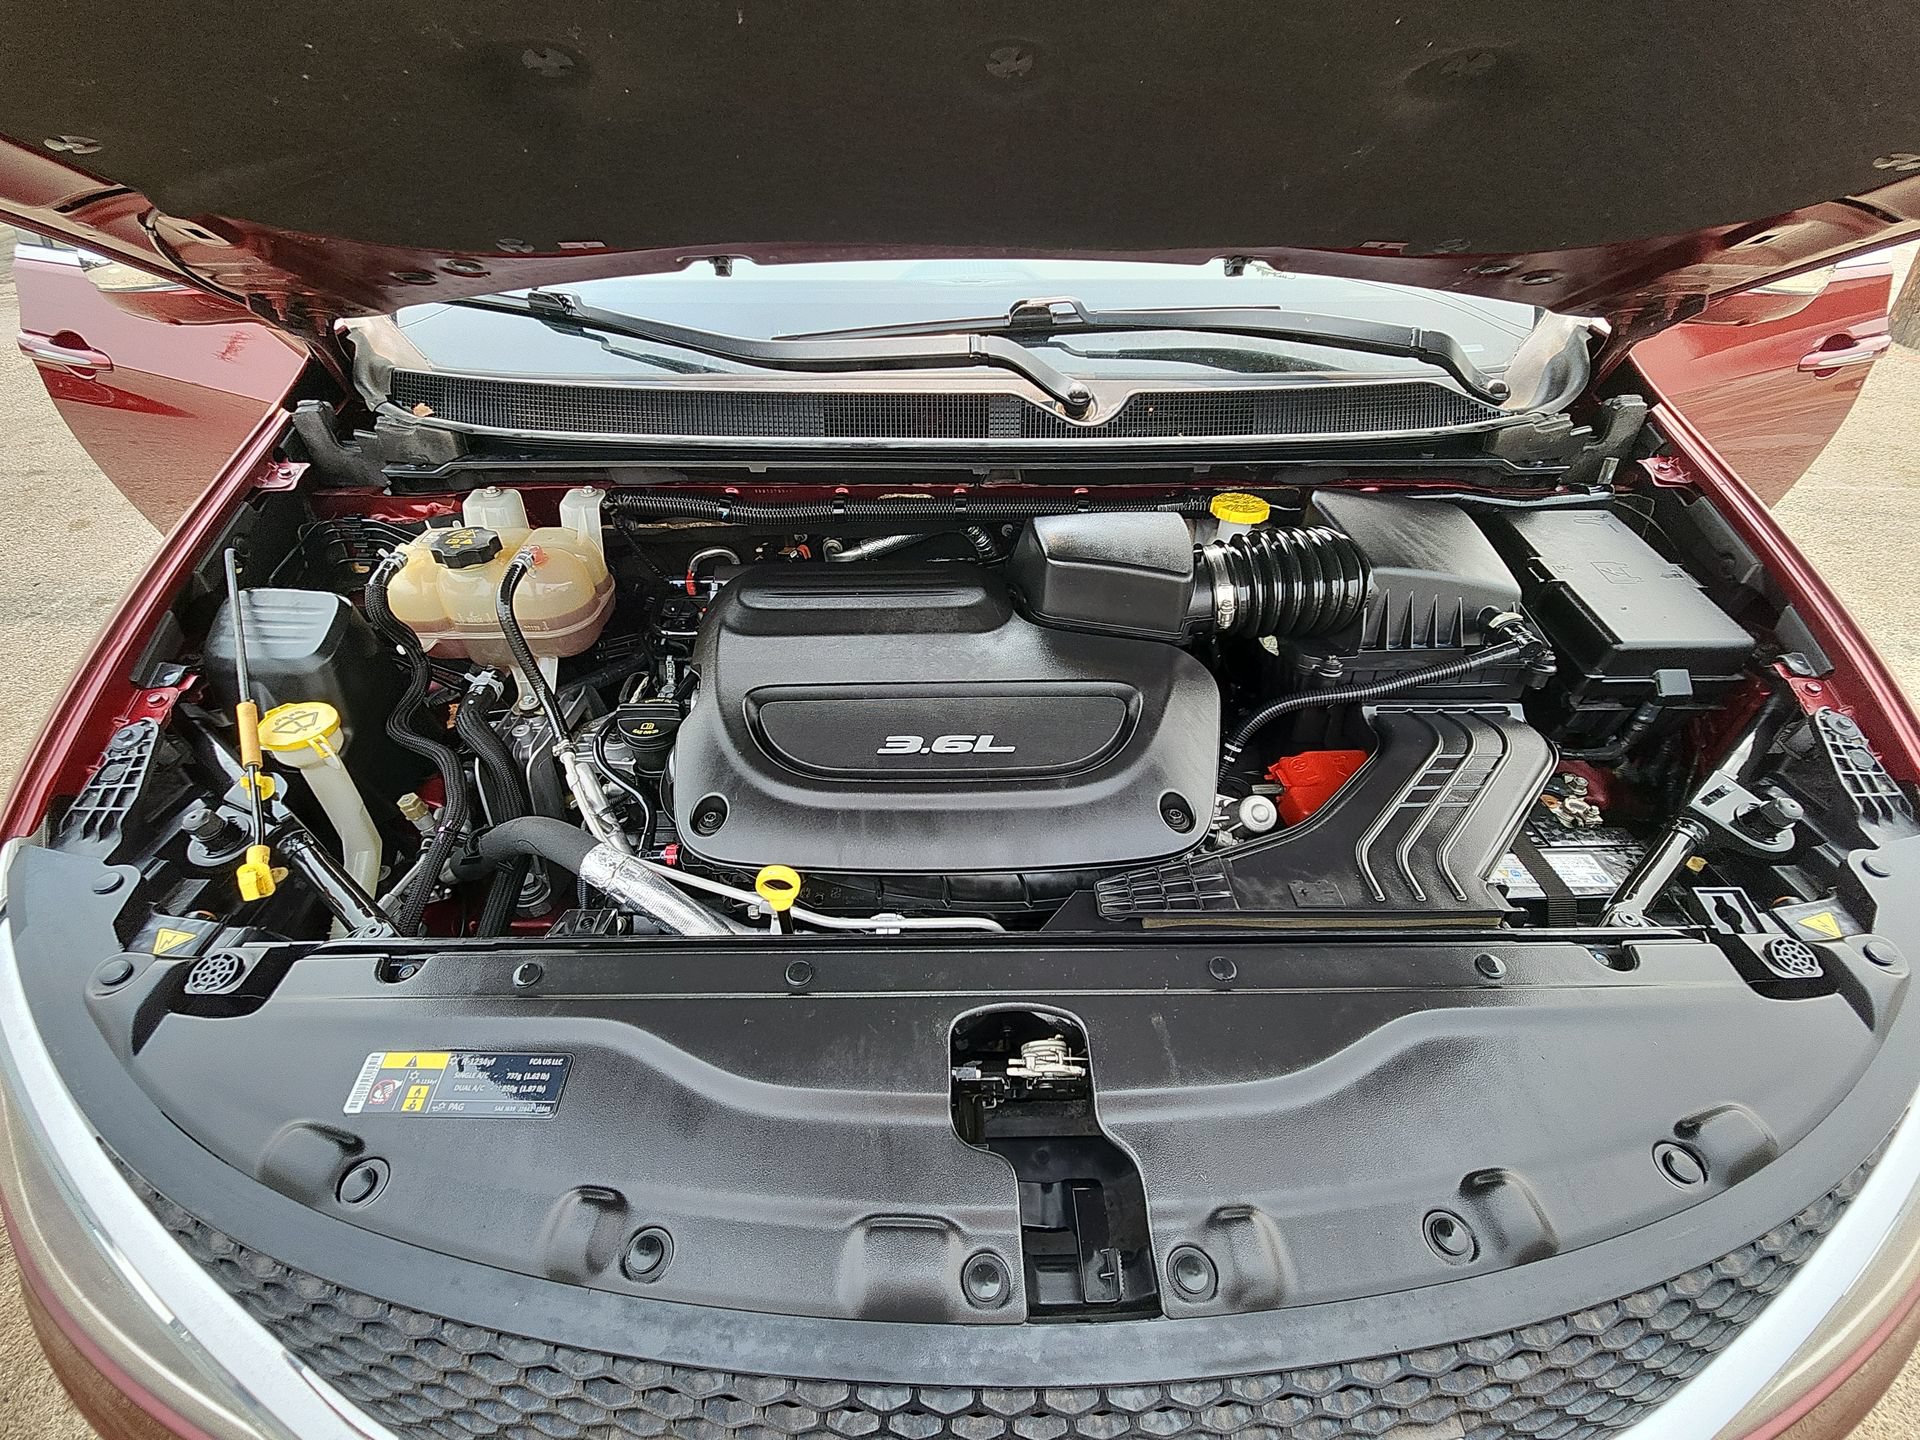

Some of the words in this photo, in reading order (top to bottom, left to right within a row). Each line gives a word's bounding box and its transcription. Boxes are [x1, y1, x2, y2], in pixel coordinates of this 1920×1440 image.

[877, 735, 1016, 754] 3.6L
[540, 1072, 550, 1080] lb)
[536, 1085, 546, 1093] lb)
